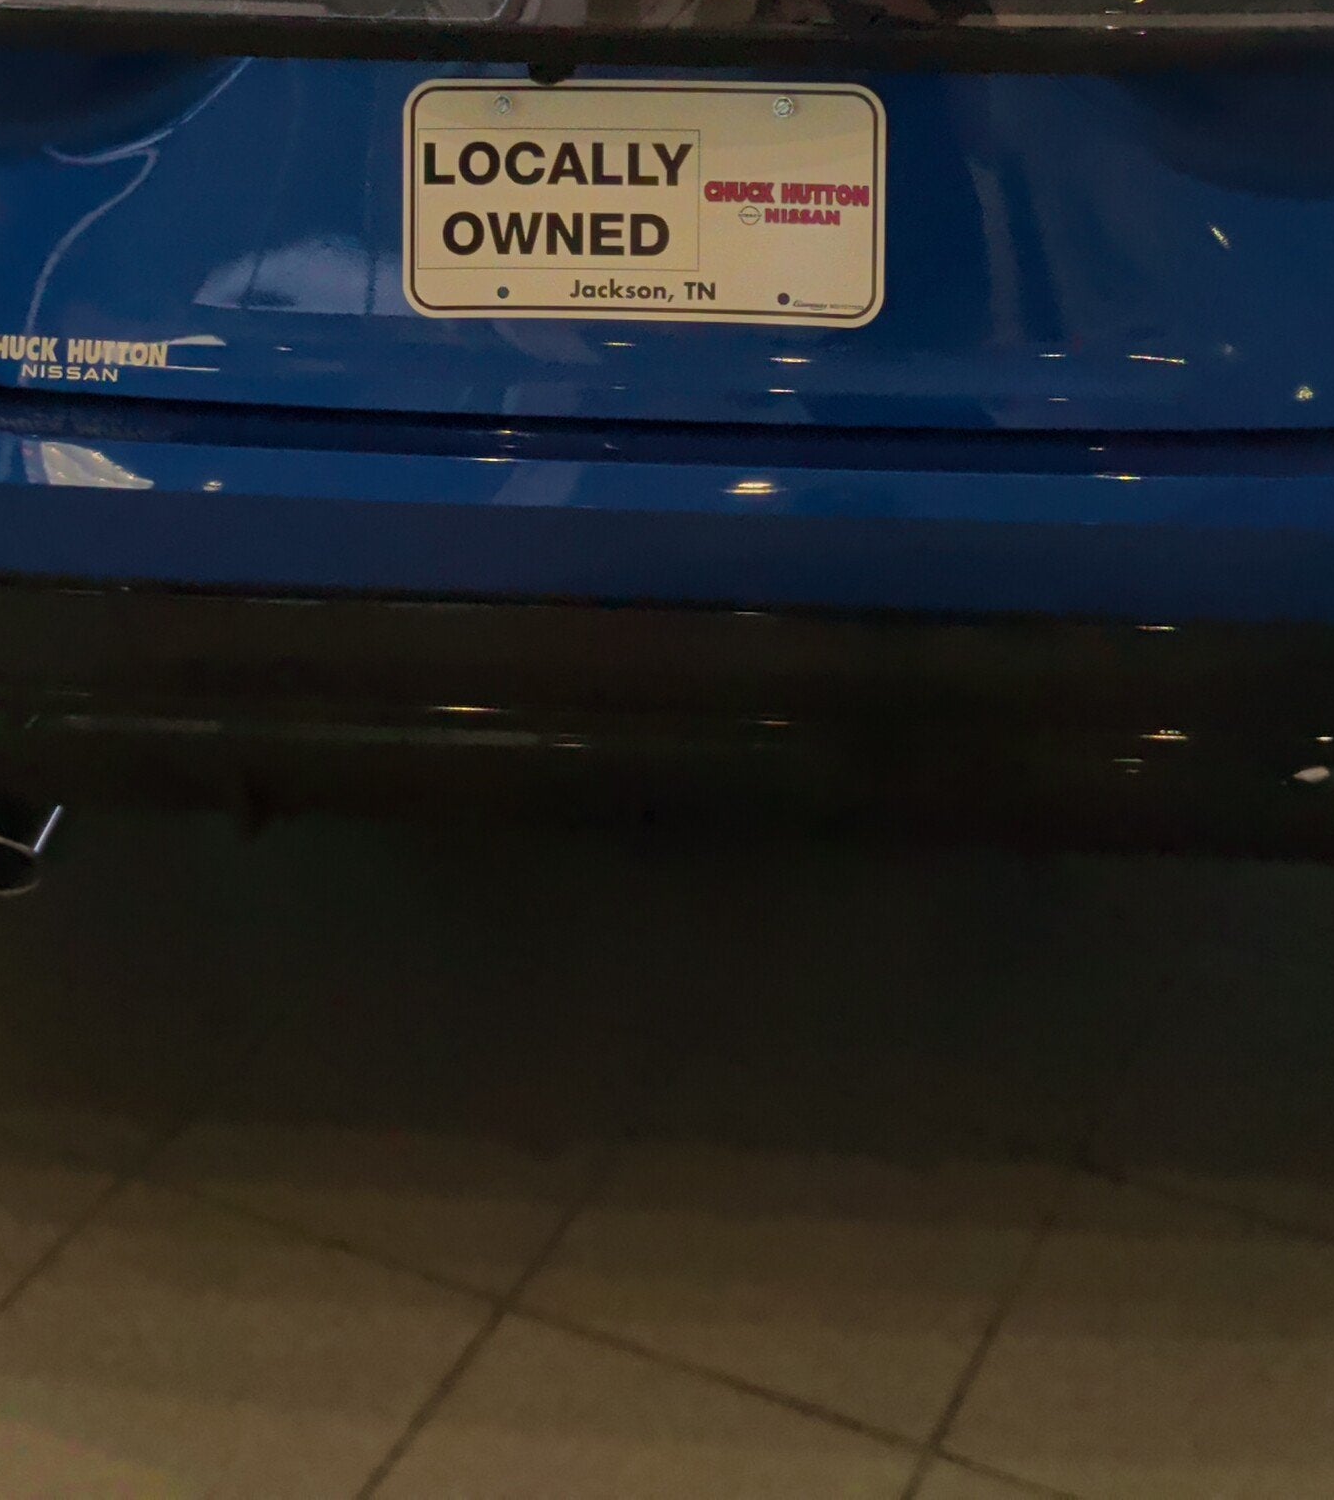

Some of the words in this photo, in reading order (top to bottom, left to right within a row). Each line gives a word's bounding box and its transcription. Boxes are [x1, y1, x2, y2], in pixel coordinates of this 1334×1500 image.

[423, 140, 694, 187] LOCALLY
[704, 180, 775, 204] CHUCK
[781, 182, 870, 207] HUTTON
[764, 207, 841, 226] NISSAN
[442, 210, 670, 257] OWNED
[569, 278, 675, 303] Jackson,
[683, 281, 717, 301] TN
[67, 338, 168, 368] HUTTON
[20, 363, 118, 383] NISSAN
